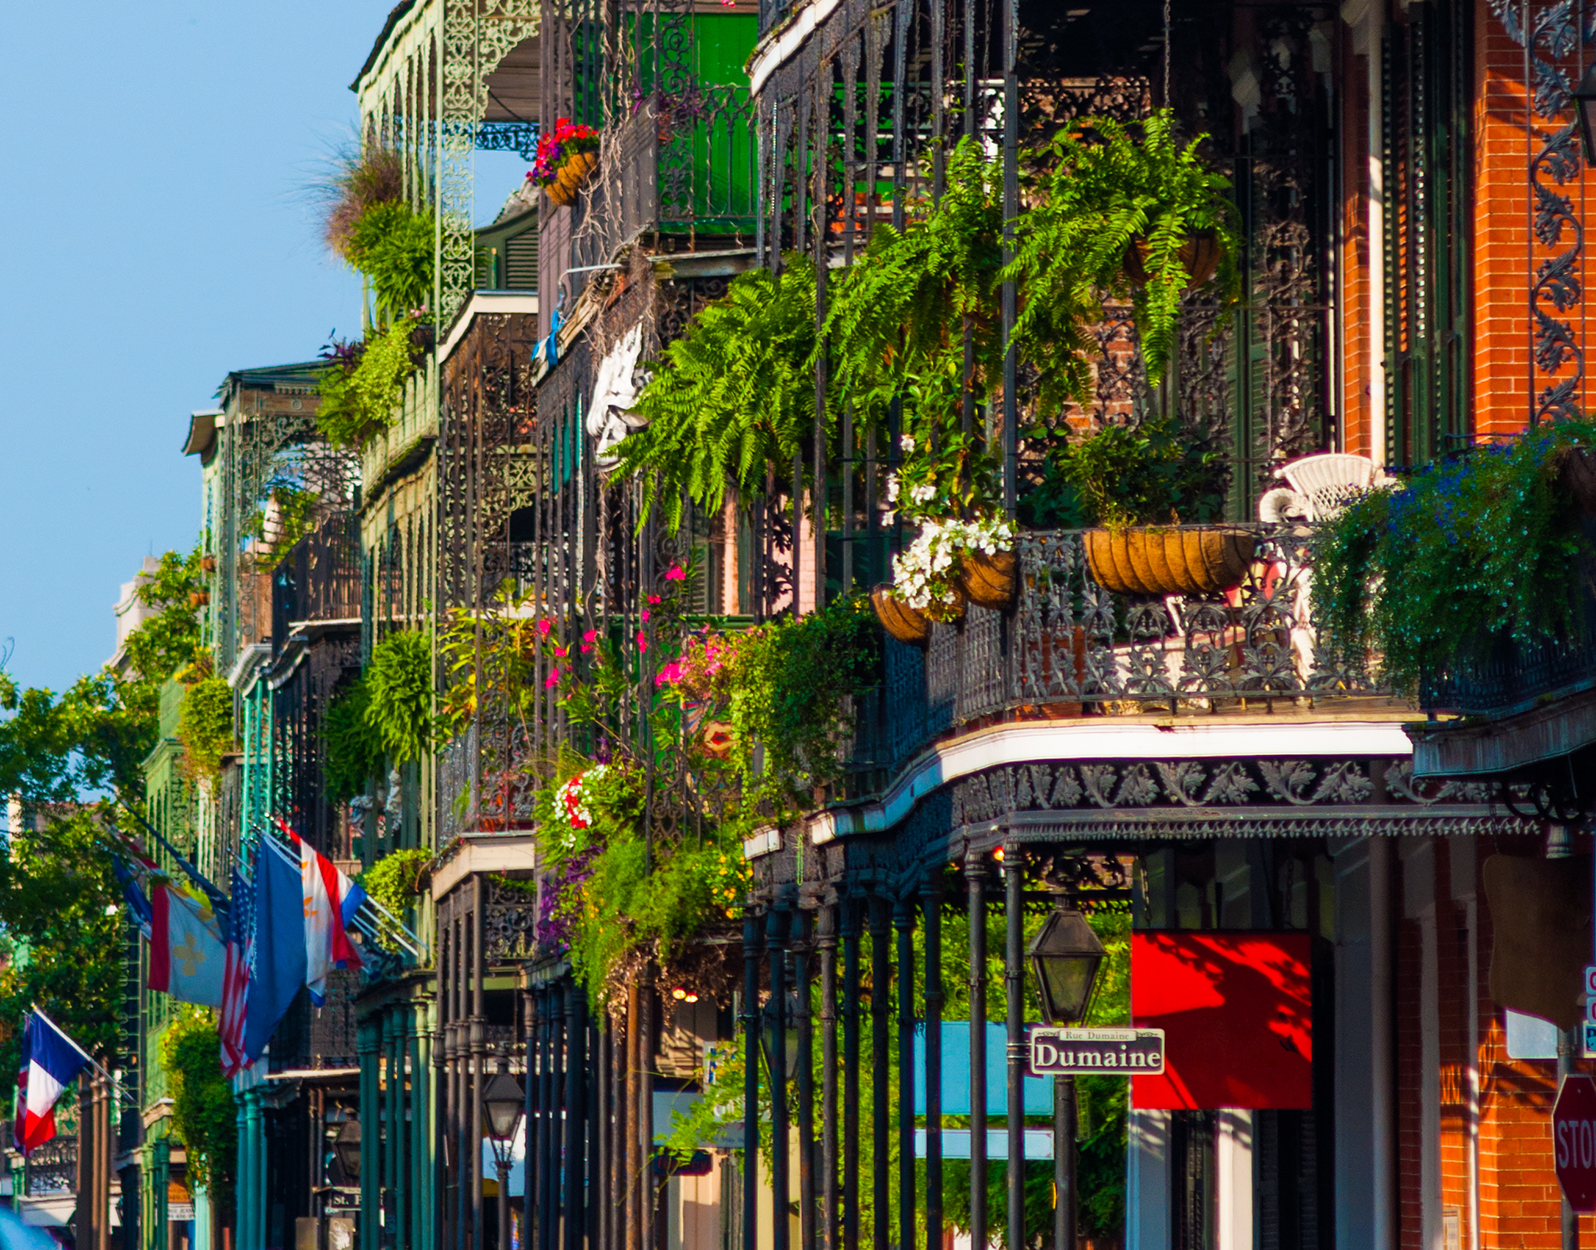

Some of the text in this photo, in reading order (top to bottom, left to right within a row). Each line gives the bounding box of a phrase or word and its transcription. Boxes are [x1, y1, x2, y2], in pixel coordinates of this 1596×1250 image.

[1065, 1031, 1130, 1040] Rue Dumaine
[1035, 1044, 1161, 1067] Dumaine
[1558, 1120, 1596, 1169] STO
[333, 1196, 349, 1205] St.
